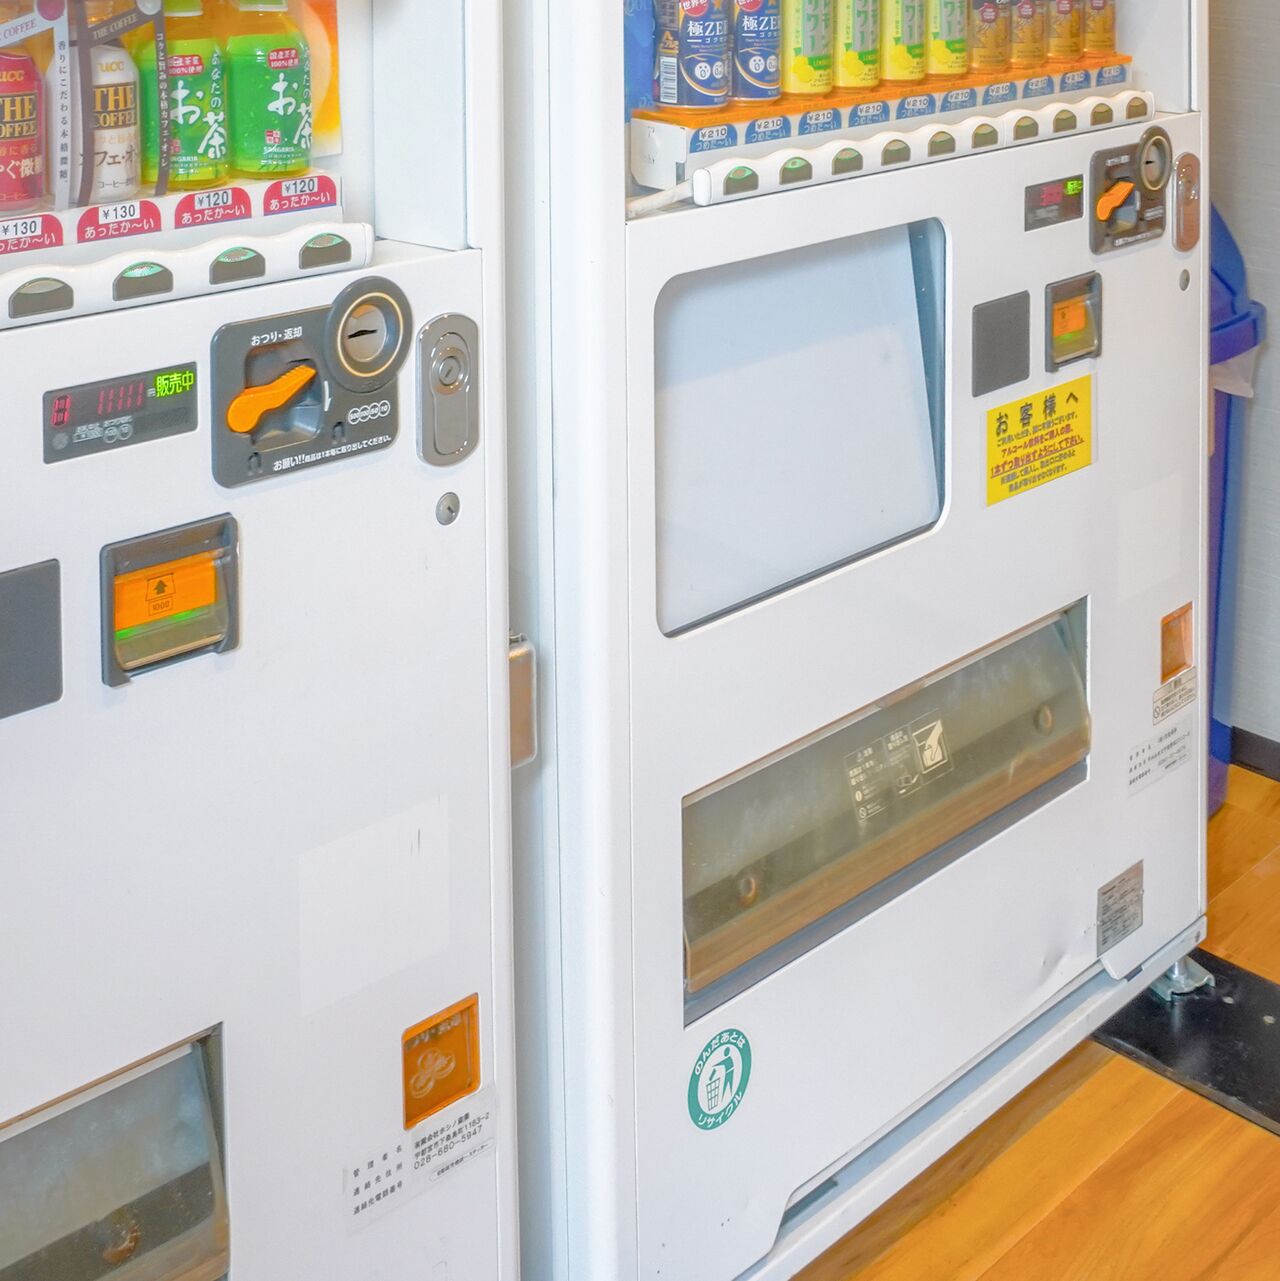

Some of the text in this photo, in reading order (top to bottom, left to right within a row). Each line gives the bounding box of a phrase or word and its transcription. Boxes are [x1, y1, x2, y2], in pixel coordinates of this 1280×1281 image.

[3, 18, 37, 40] COFFEE
[110, 14, 137, 34] COFFEE
[859, 104, 882, 114] ¥210
[905, 98, 928, 108] ¥210
[756, 118, 782, 130] ¥210
[808, 111, 833, 122] ¥210
[700, 128, 727, 140] ¥210
[250, 326, 303, 347] おつり・返却
[156, 370, 195, 397] 販売中
[996, 391, 1079, 438] お客様へ
[694, 1031, 746, 1076] のんだあとは
[698, 1092, 743, 1128] リサイクル
